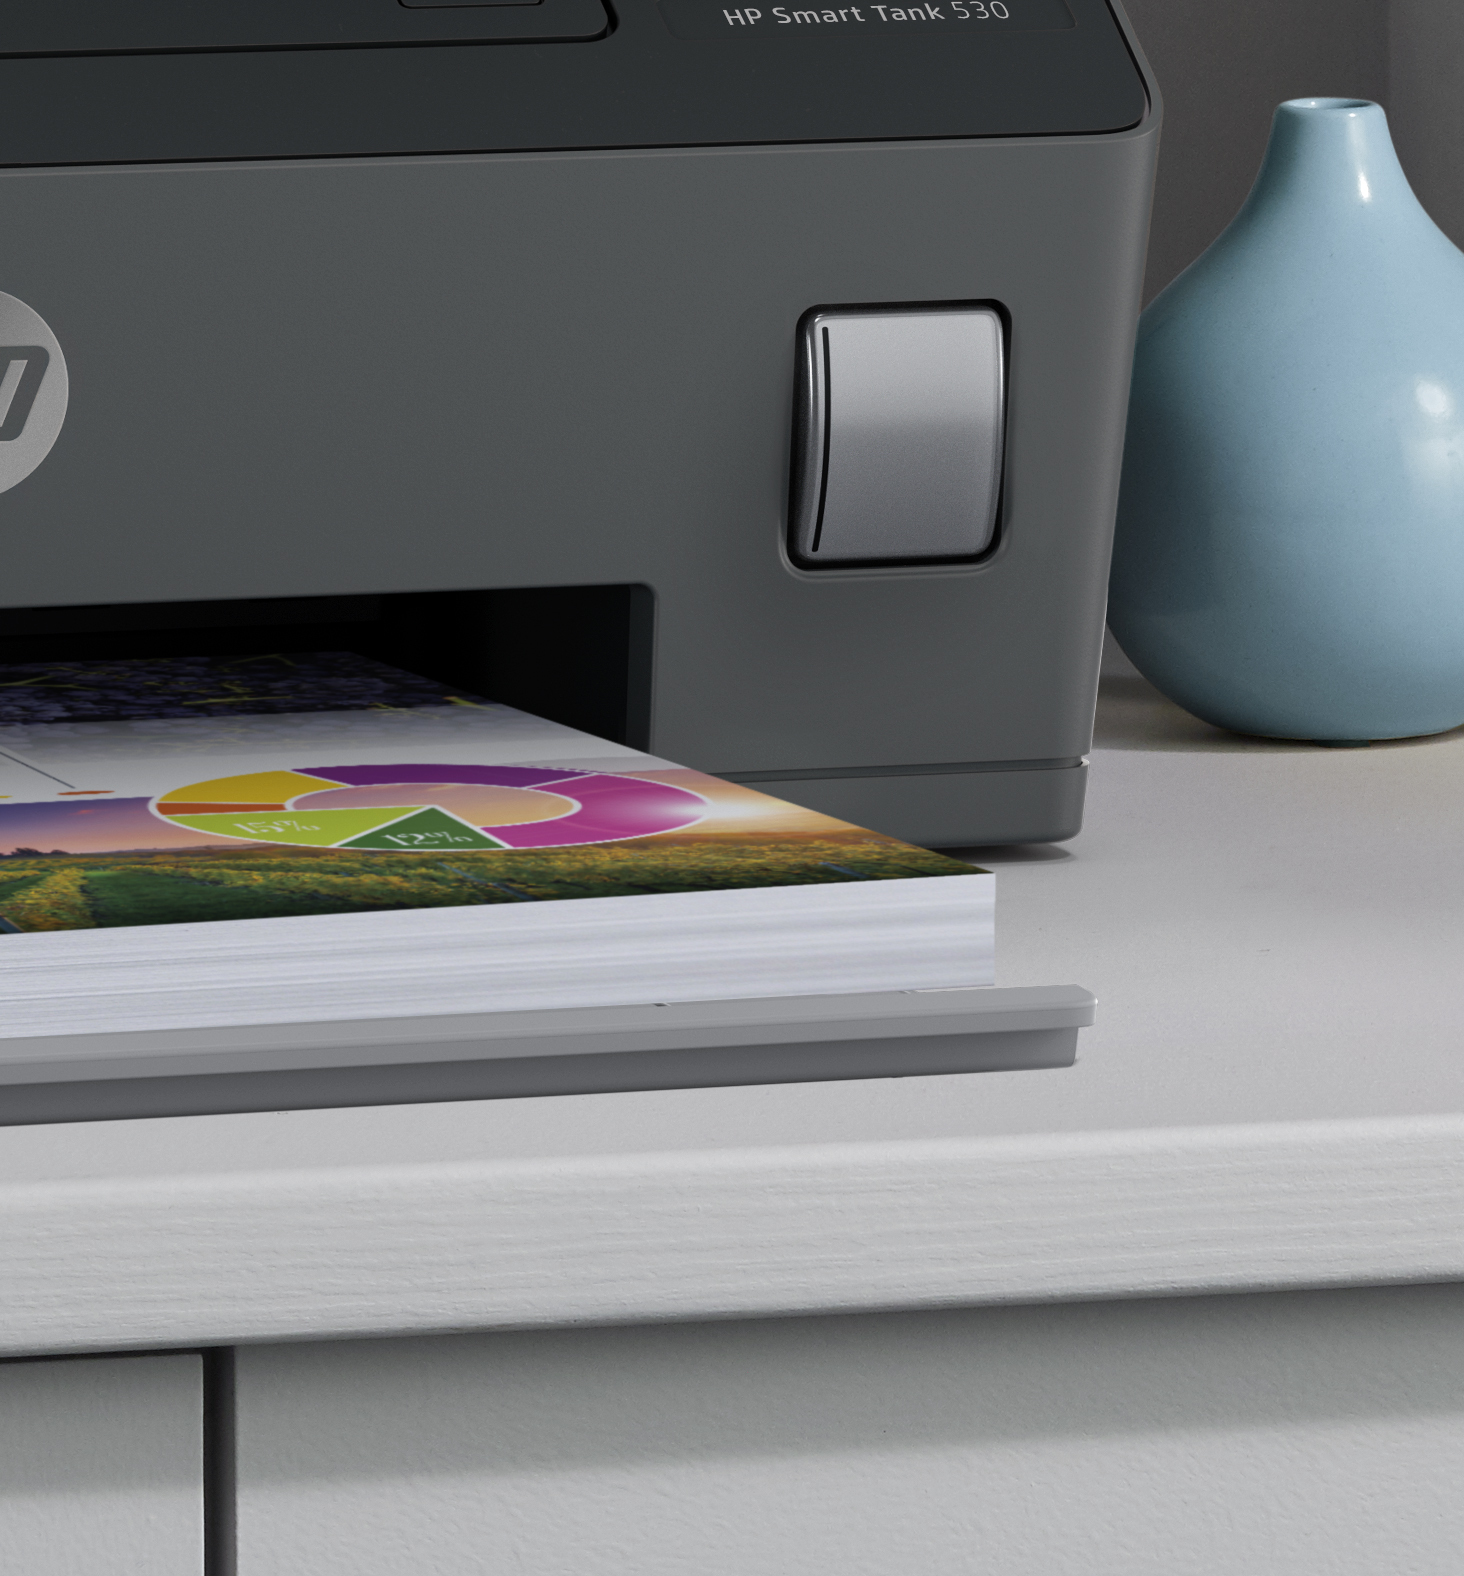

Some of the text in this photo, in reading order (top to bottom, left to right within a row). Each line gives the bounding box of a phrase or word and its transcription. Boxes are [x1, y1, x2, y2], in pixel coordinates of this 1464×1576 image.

[723, 1, 1010, 26] HP Smart Tank 530
